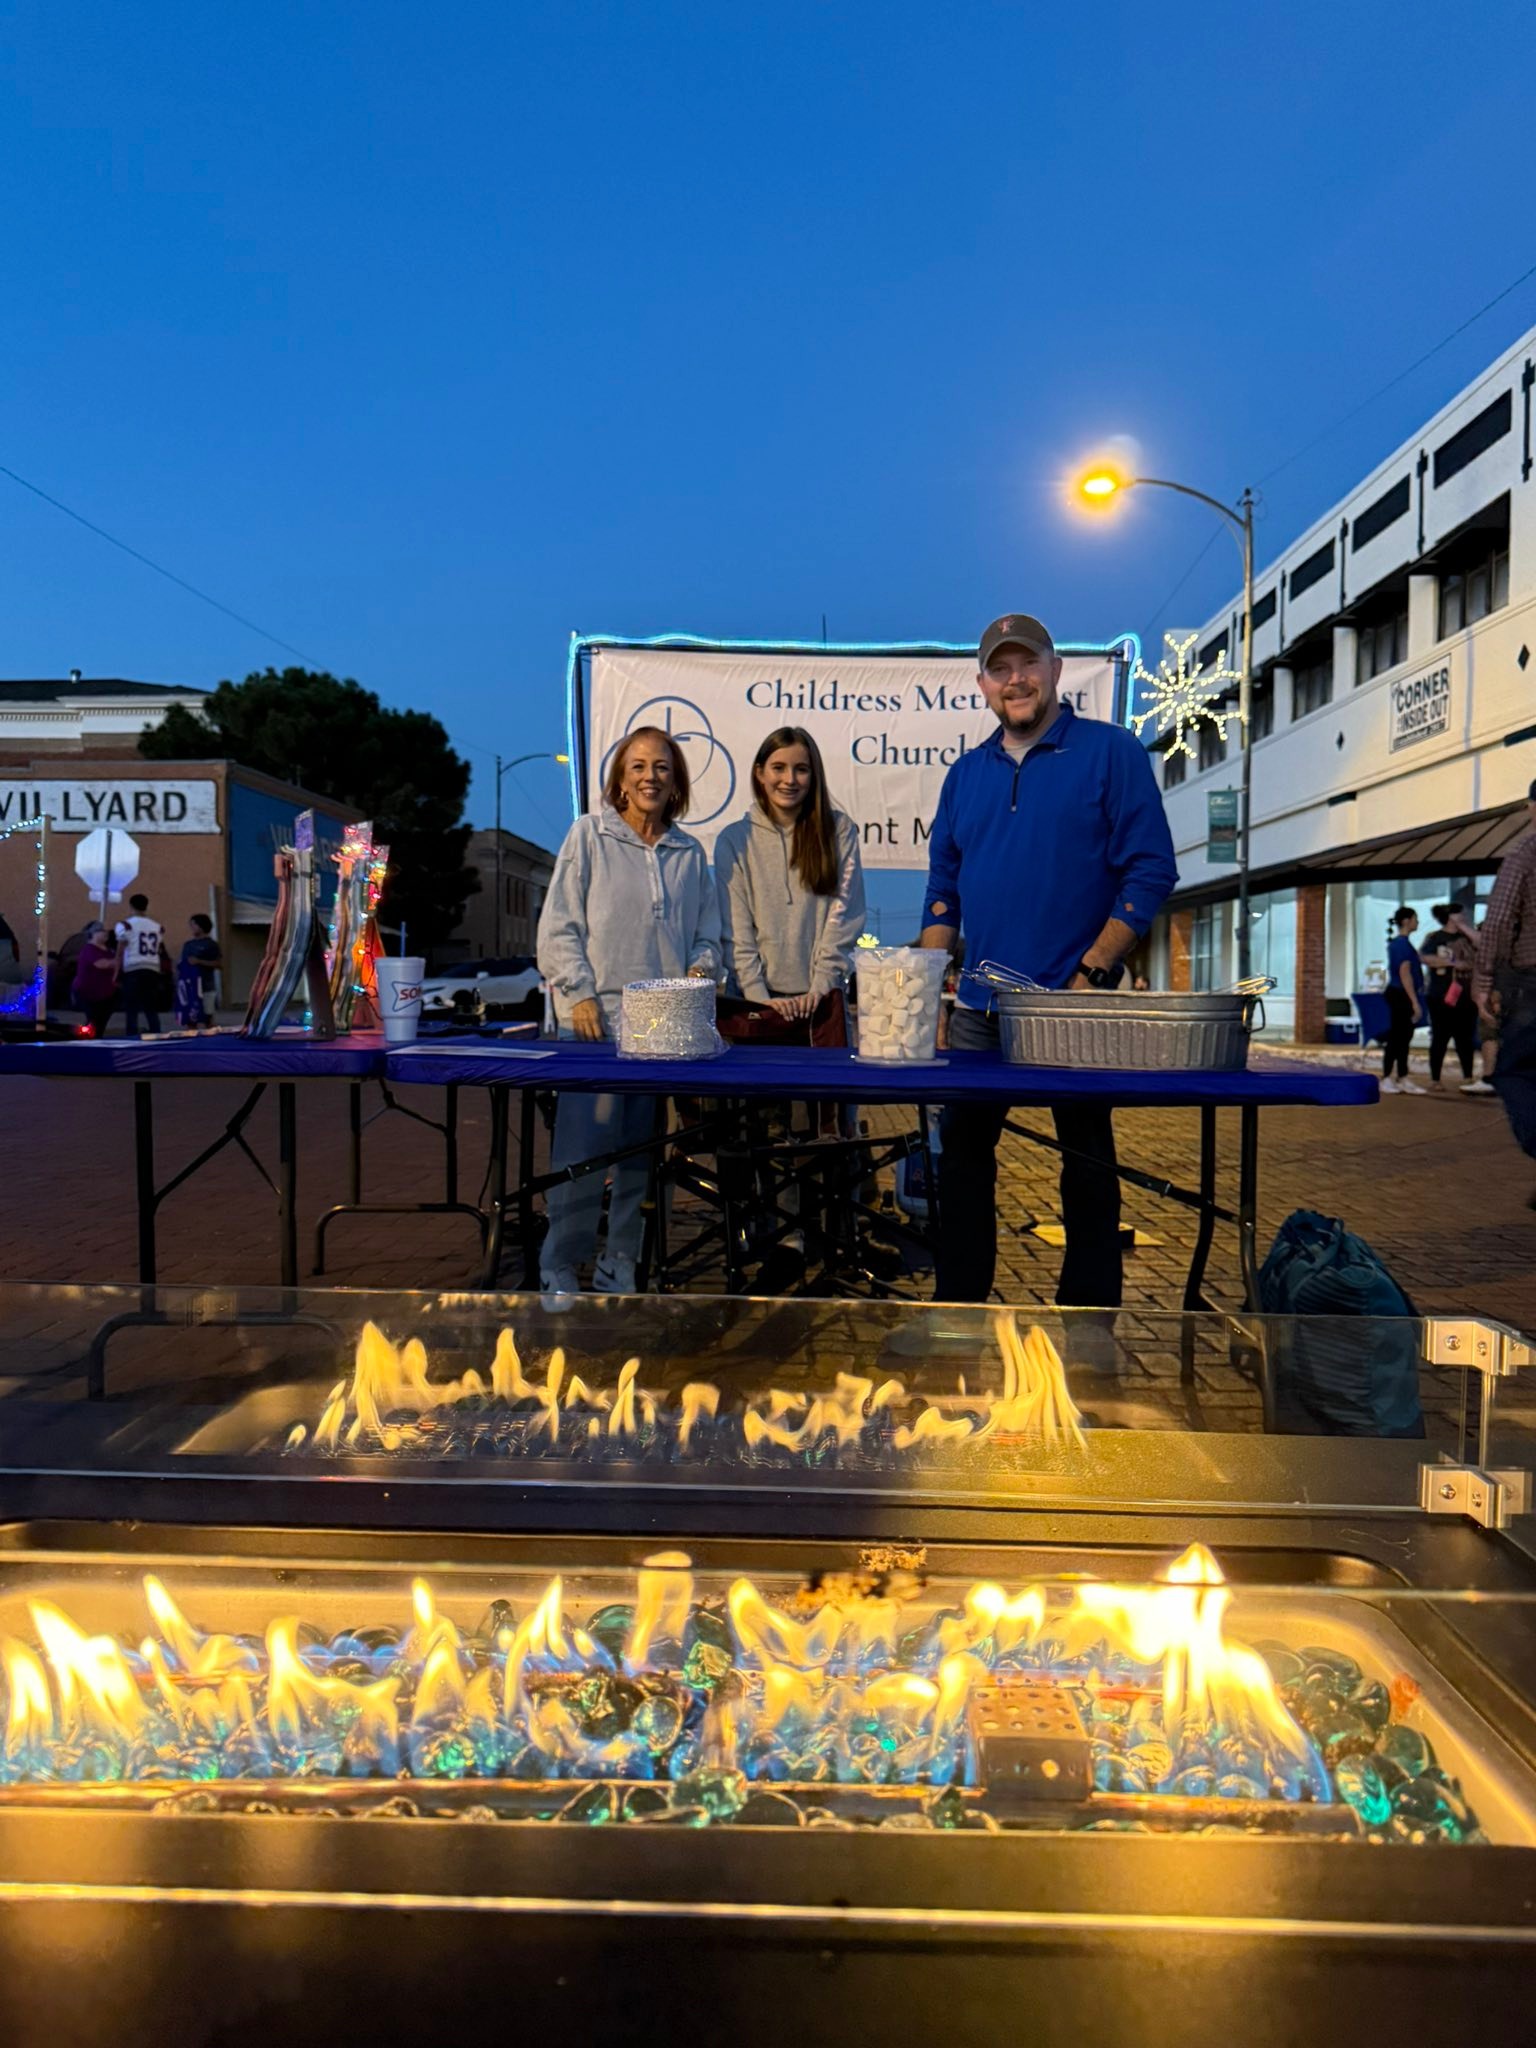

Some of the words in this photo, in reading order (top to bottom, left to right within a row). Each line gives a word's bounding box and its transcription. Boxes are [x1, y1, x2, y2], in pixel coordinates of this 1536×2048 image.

[746, 679, 902, 712] Childress
[914, 684, 1088, 712] Metst
[1396, 667, 1450, 713] CORNER
[1401, 703, 1428, 732] INSIDE
[1430, 694, 1449, 720] OUT
[139, 932, 158, 956] 63
